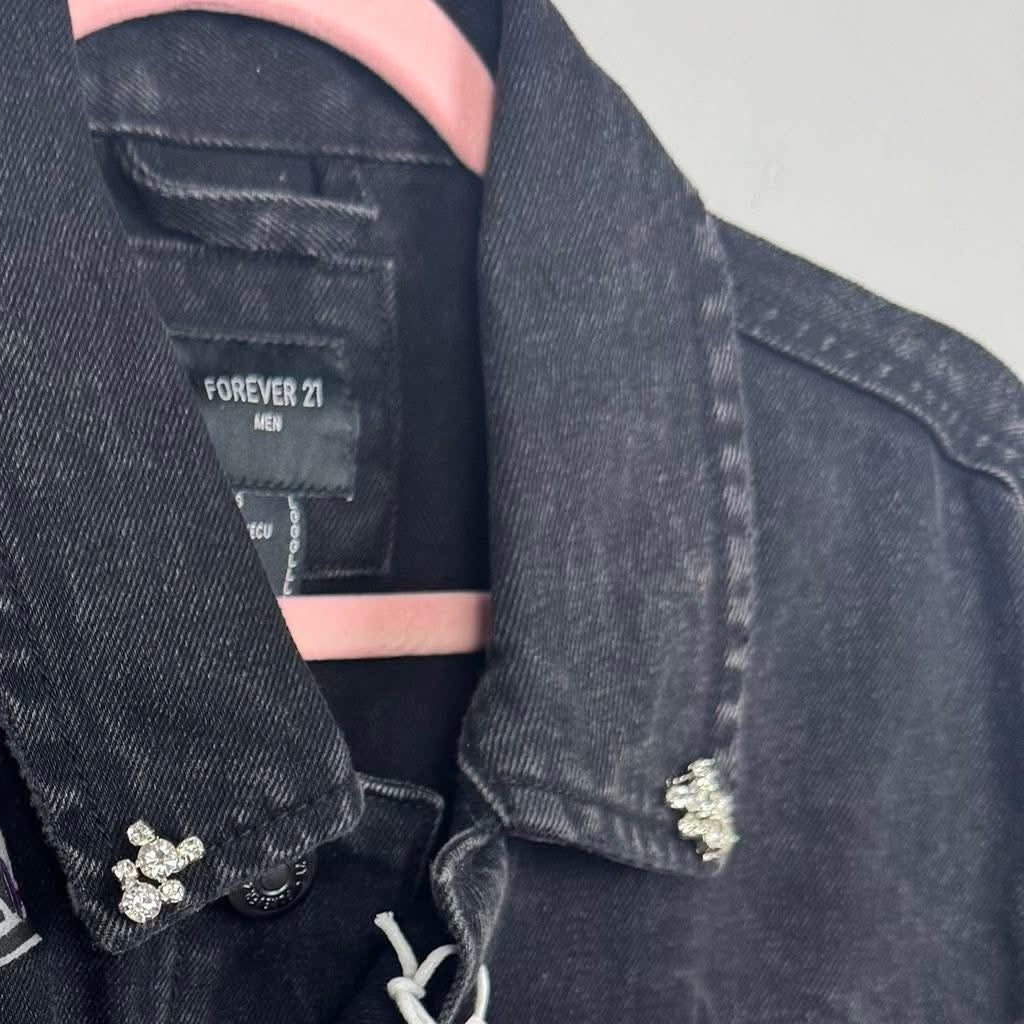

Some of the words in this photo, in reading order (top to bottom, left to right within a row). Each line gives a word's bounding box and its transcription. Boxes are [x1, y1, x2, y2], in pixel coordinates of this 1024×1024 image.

[204, 374, 298, 407] FOREVER
[301, 377, 324, 408] 21
[253, 413, 283, 432] MEN
